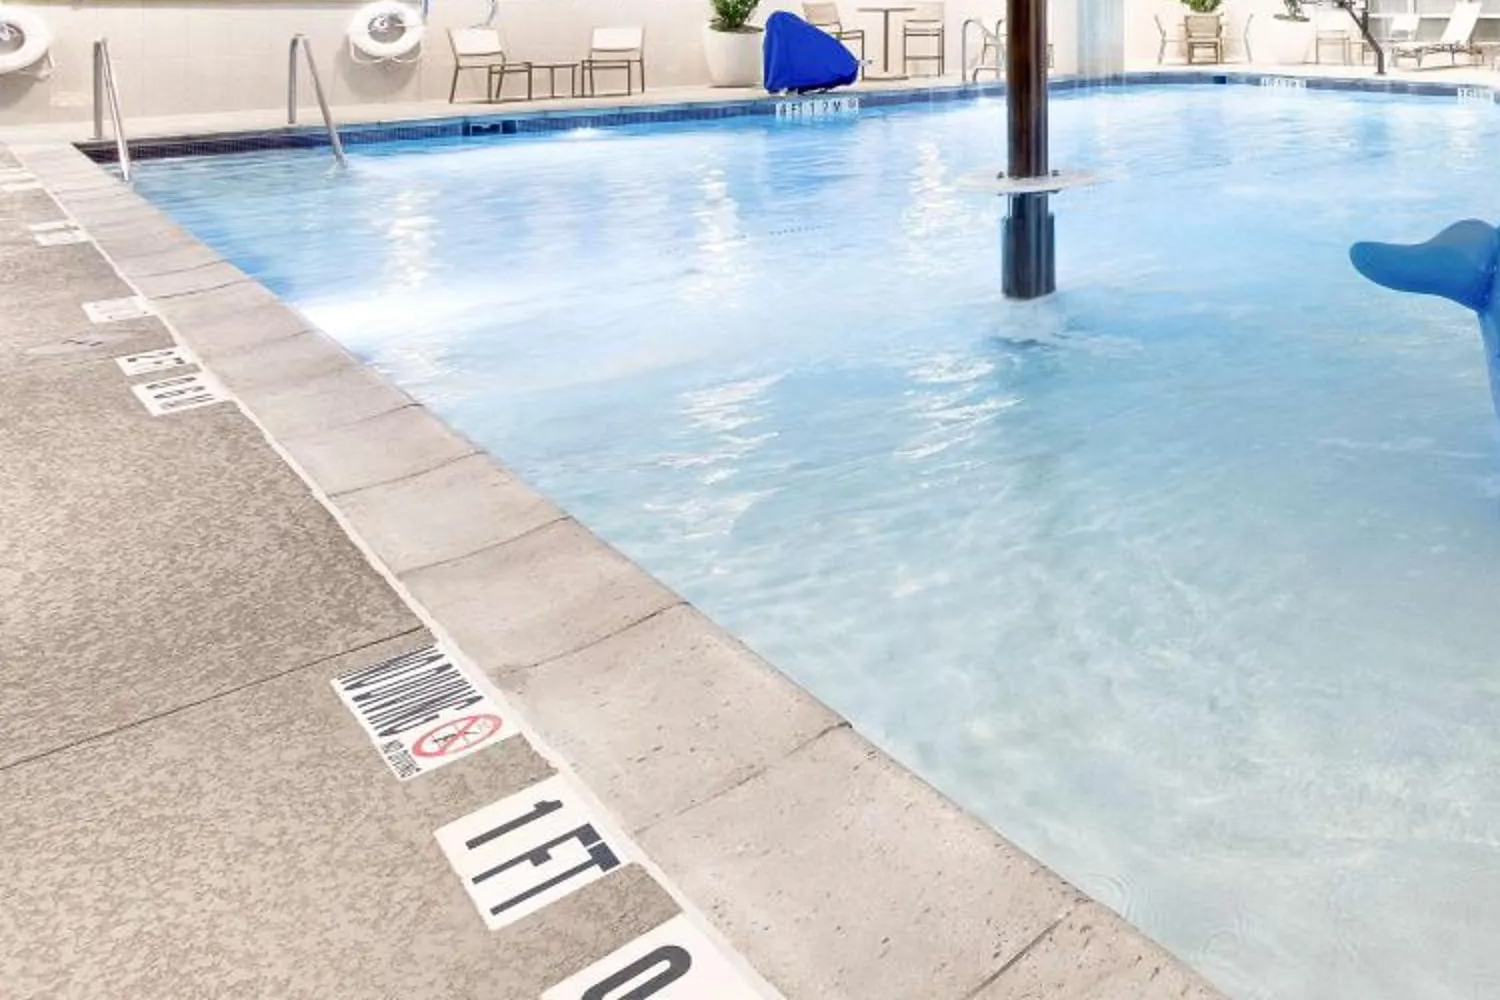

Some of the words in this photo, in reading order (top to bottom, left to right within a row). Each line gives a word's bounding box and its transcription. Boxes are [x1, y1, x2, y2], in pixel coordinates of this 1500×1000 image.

[351, 662, 485, 738] DIVING
[465, 799, 563, 850] 1
[471, 823, 621, 916] FT
